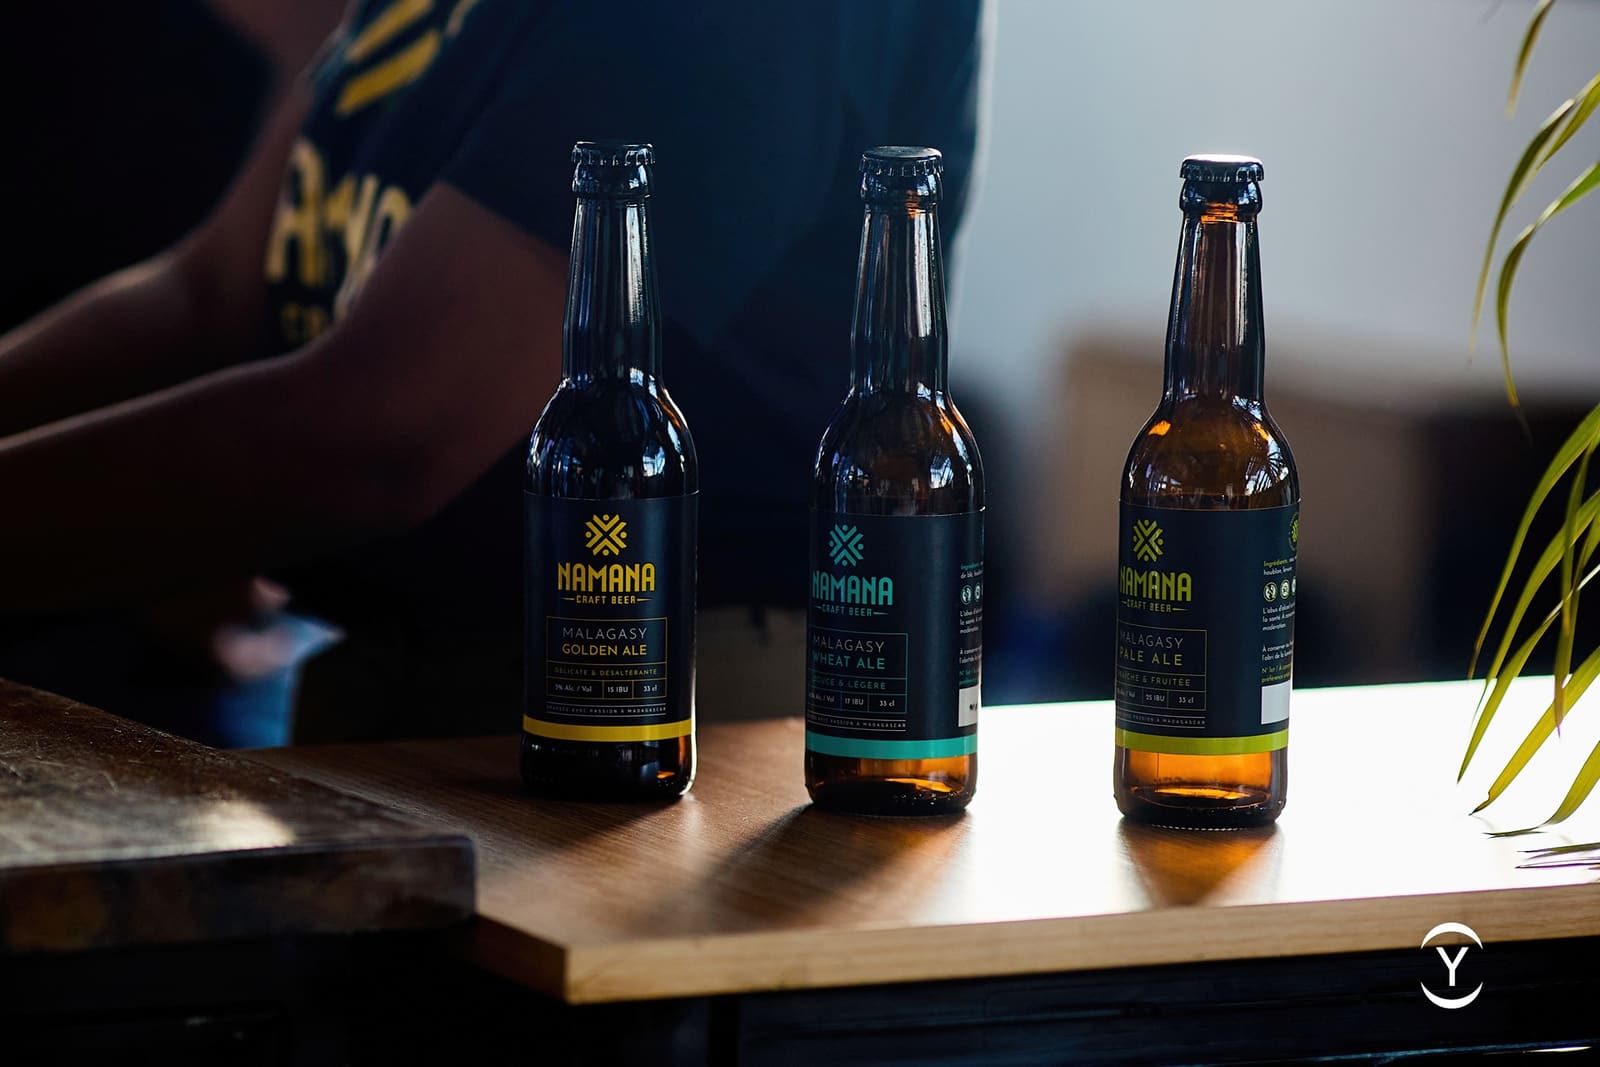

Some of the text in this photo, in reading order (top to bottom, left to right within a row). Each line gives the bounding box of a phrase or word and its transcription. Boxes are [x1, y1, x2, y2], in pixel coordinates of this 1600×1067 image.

[557, 562, 656, 593] NAMANA
[1120, 565, 1192, 602] NAMANA
[812, 570, 894, 606] NAMANA
[576, 595, 636, 605] CRAFT BEER
[1127, 599, 1172, 613] CRAFT BEER
[821, 605, 872, 617] CRAFT BEER
[562, 627, 648, 640] MALAGASY
[562, 643, 648, 656] GOLDEN ALE
[813, 633, 885, 653] MALAGASY
[1119, 646, 1183, 666] PALE ALE
[856, 657, 886, 670] ALE
[888, 699, 895, 707] cl
[1178, 696, 1187, 704] 33
